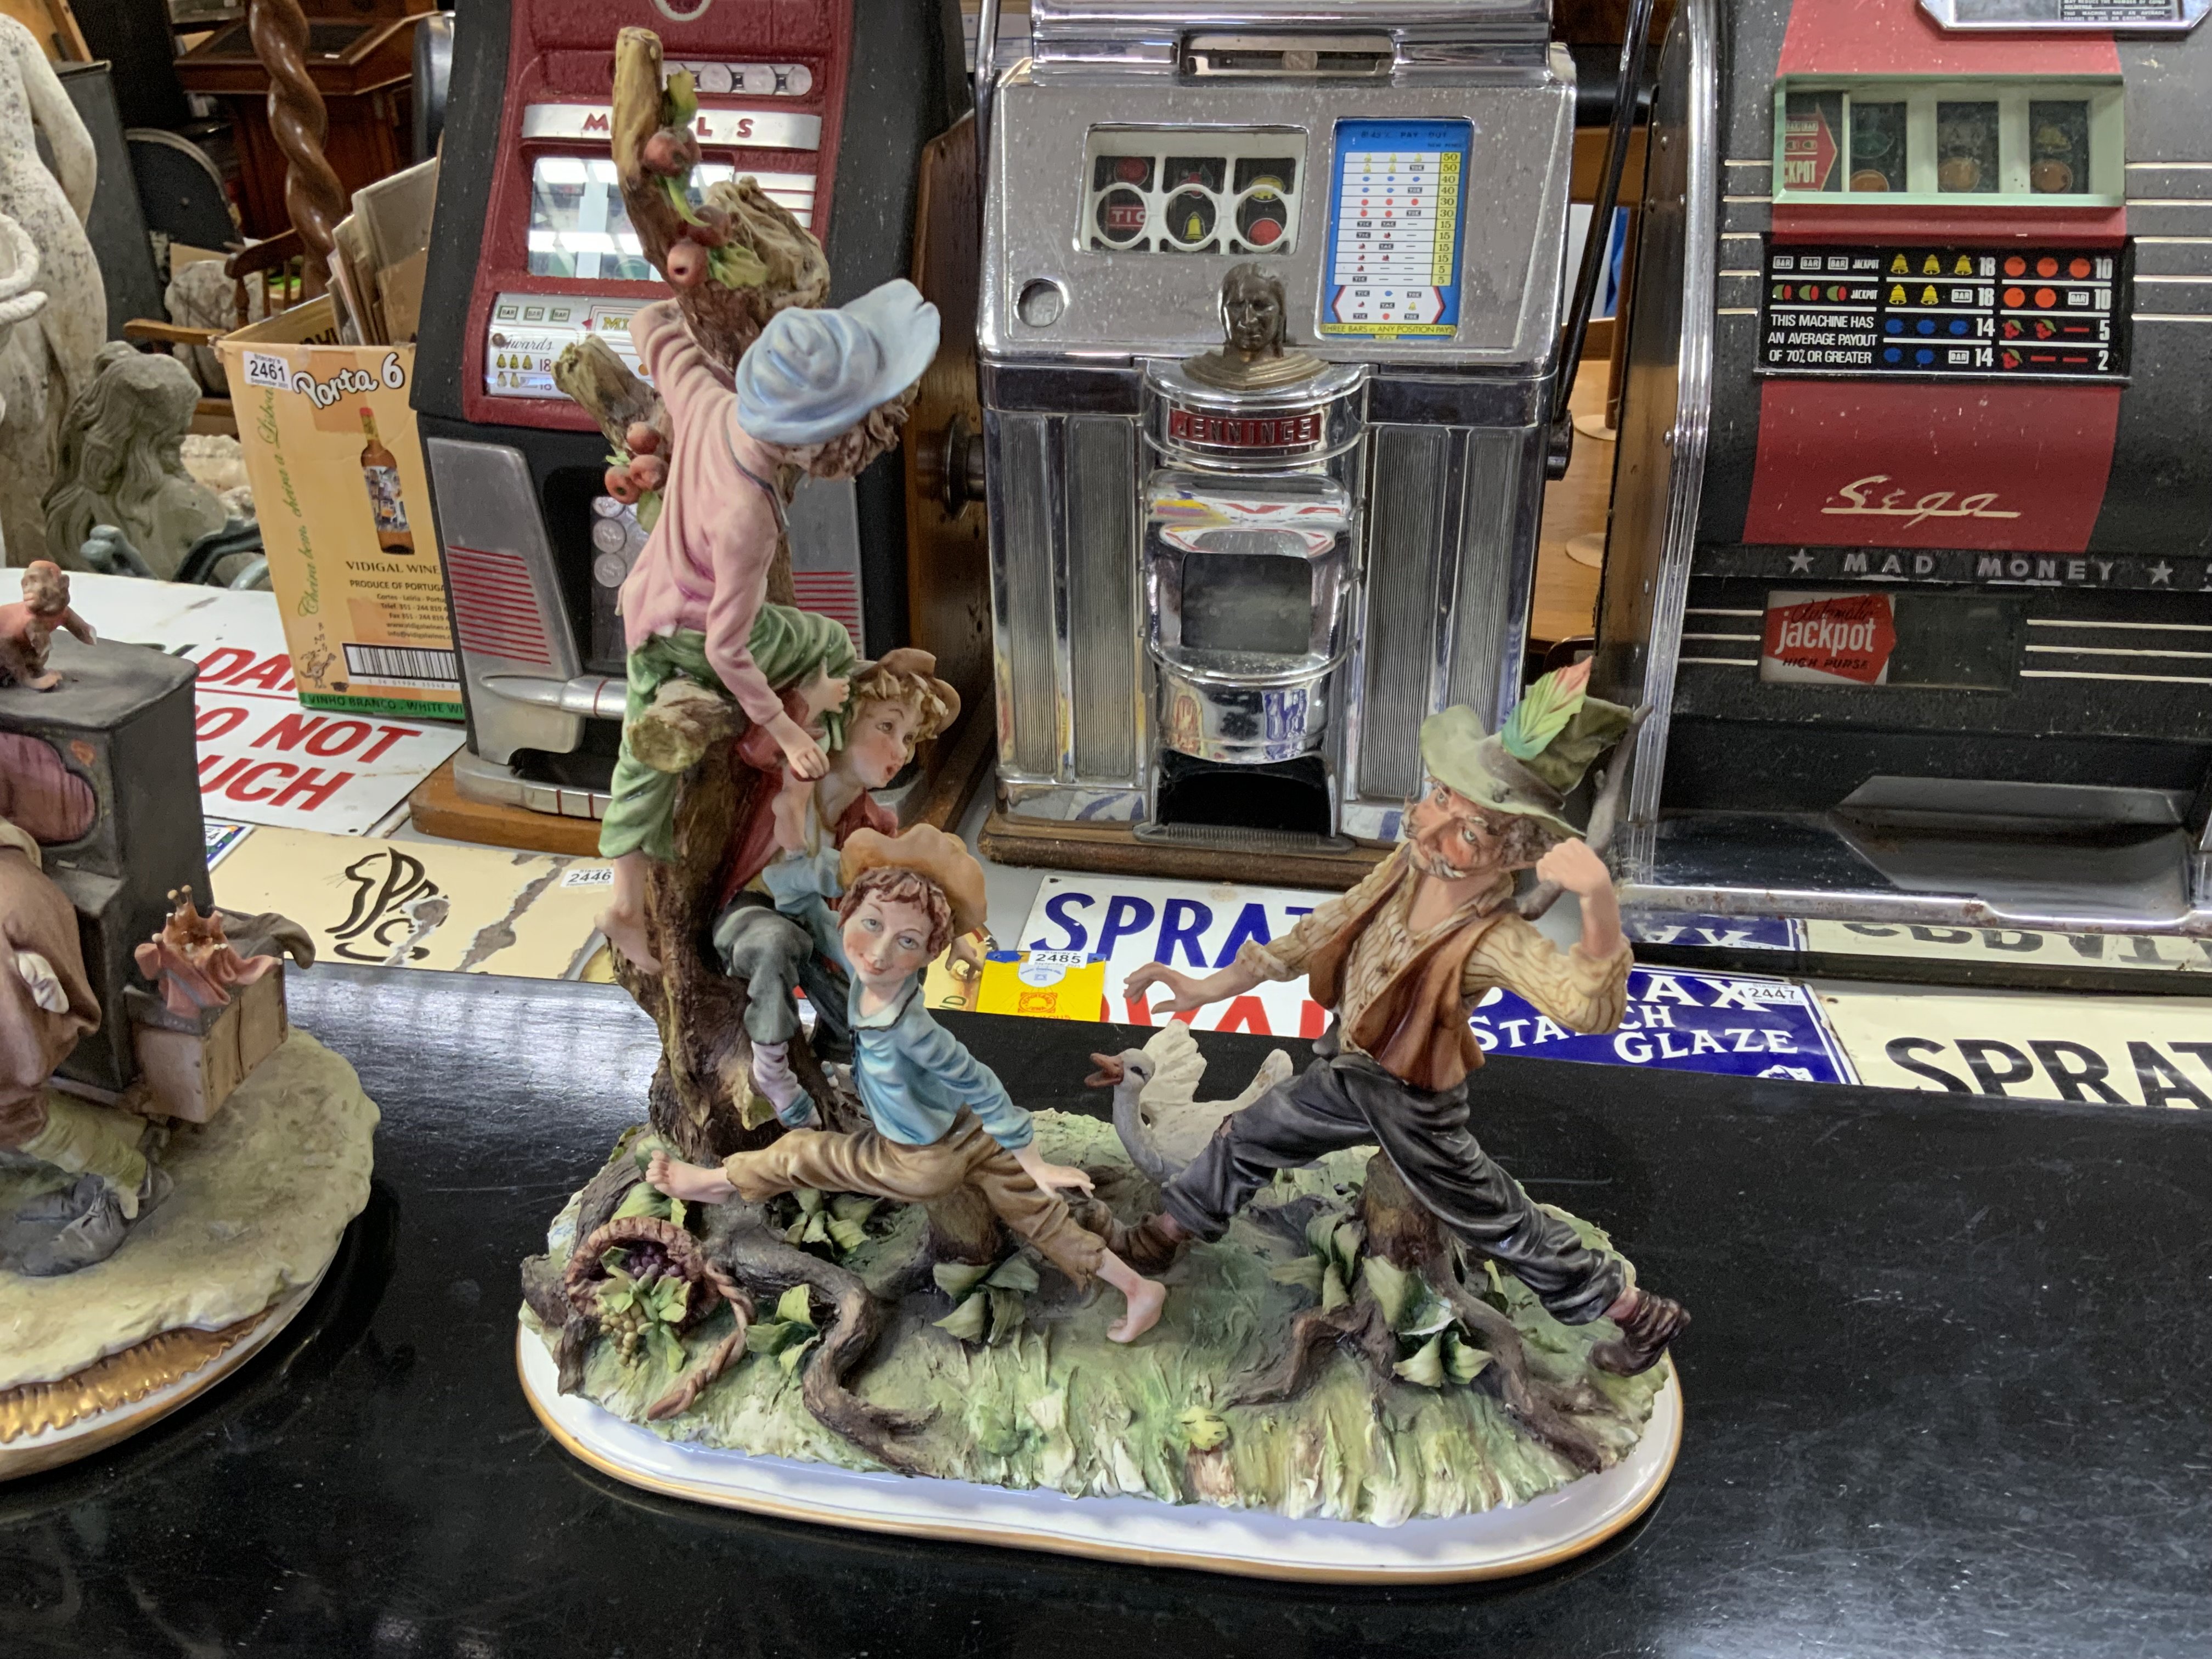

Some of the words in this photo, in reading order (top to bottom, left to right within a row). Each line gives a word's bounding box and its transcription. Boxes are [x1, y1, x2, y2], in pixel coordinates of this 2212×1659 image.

[583, 113, 755, 138] MLS
[1111, 210, 1146, 223] TIC
[1775, 258, 1790, 267] BAR
[1803, 258, 1818, 267] BAR
[1830, 259, 1846, 268] BAR
[1853, 259, 1879, 269] JACKPOT
[1979, 257, 1996, 276] 18
[2095, 258, 2112, 279] 10
[1850, 290, 1877, 300] JACKPOT
[1954, 292, 1970, 300] BAR
[1978, 288, 1994, 306] 18
[2070, 294, 2086, 303] BAR
[2094, 289, 2112, 309] 10
[1771, 314, 1796, 326] THIS
[1799, 315, 1848, 328] MACHINE
[1850, 316, 1874, 328] HAS
[1976, 318, 1995, 336] 14
[2099, 320, 2110, 340] 5
[1768, 332, 1785, 344] AN
[1788, 333, 1835, 345] AVERAGE
[1838, 334, 1877, 346] PAYOUT
[540, 358, 551, 372] 18
[1769, 350, 1784, 362] OF
[1786, 349, 1805, 363] 70%
[1808, 350, 1822, 363] OR
[1825, 351, 1871, 364] GREATER
[1950, 352, 1967, 361] BAR
[1975, 348, 1994, 366] 14
[2098, 350, 2109, 370] 2
[250, 360, 285, 382] 2461
[291, 368, 380, 409] Porta
[381, 351, 405, 389] 6
[1178, 417, 1311, 444] JENNINGS
[1821, 475, 2021, 529] Sega
[346, 561, 403, 573] VIDIGAL
[1844, 553, 1934, 574] MAD
[1978, 555, 2115, 580] MONEY
[350, 580, 390, 589] PRODUCE
[1774, 611, 1876, 657] jackpot
[1783, 658, 1817, 668] HIGH
[309, 695, 346, 706] VINHO
[348, 697, 396, 709] BRANCO
[407, 701, 445, 713] WHITE
[249, 714, 423, 763] NOT
[568, 871, 612, 883] 2446
[1029, 892, 1316, 968] SPRA
[1035, 953, 1081, 964] 2485
[1748, 988, 1795, 1000] 2447
[1469, 1005, 1676, 1052] STACH
[1614, 1028, 1798, 1064] GLAZE
